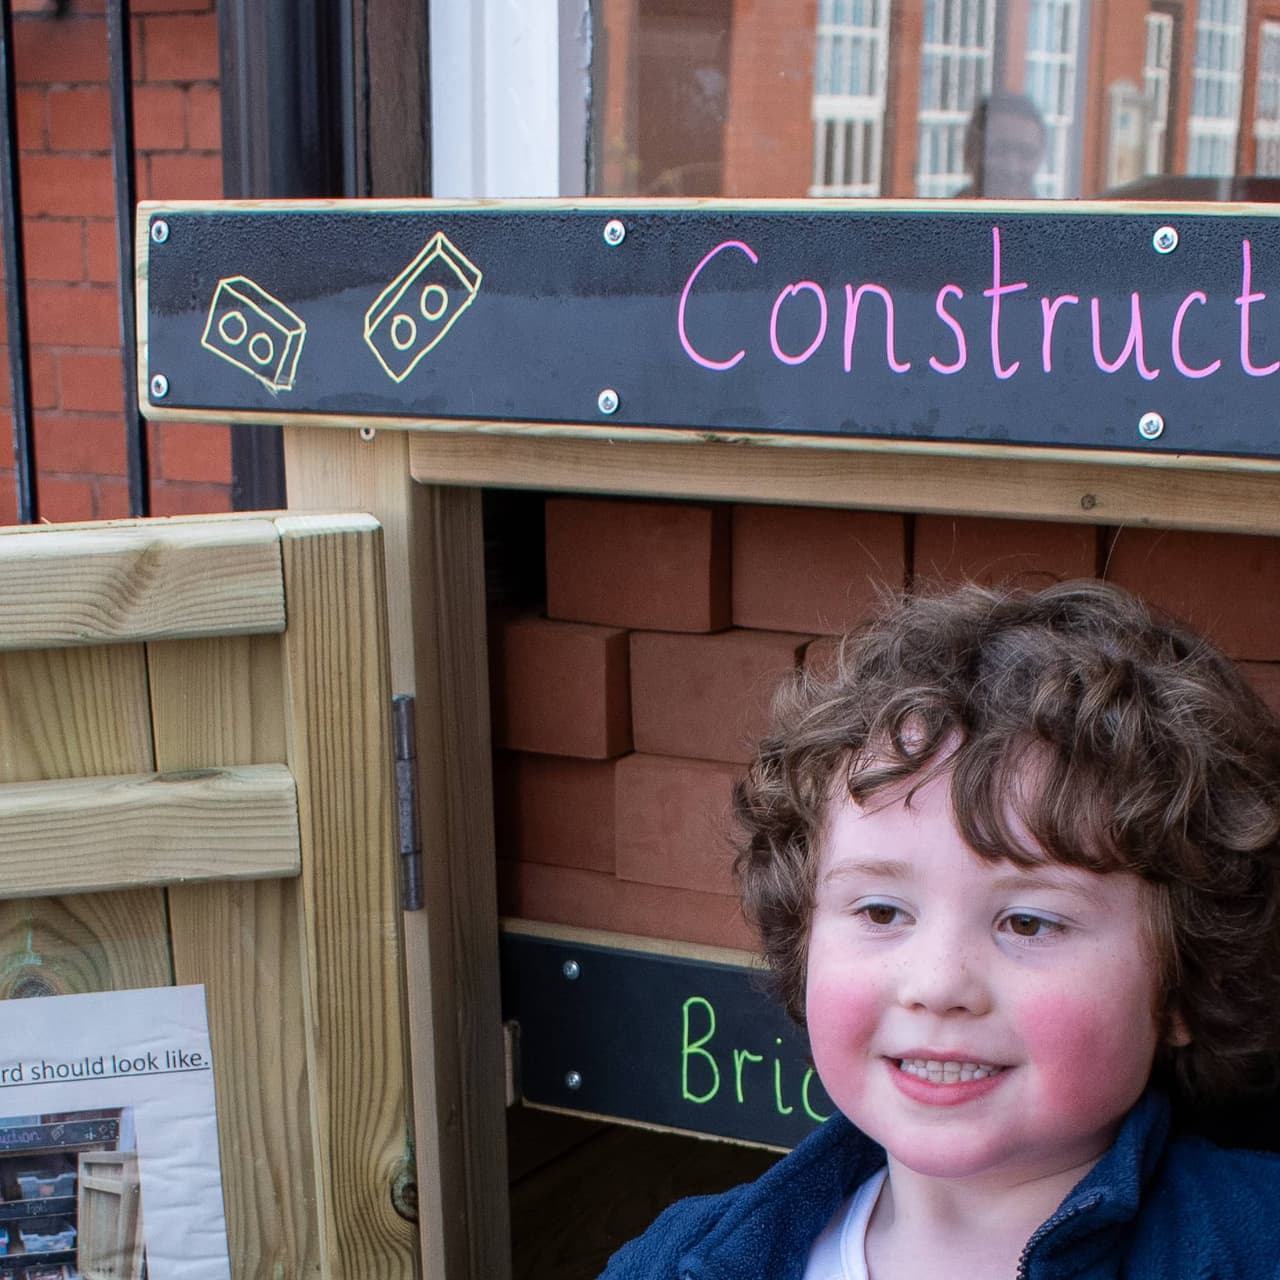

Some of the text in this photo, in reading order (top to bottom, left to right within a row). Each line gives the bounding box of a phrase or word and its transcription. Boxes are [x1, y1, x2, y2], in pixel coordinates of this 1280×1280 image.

[31, 1056, 105, 1081] should
[112, 1051, 159, 1074] look
[165, 1048, 209, 1069] like.
